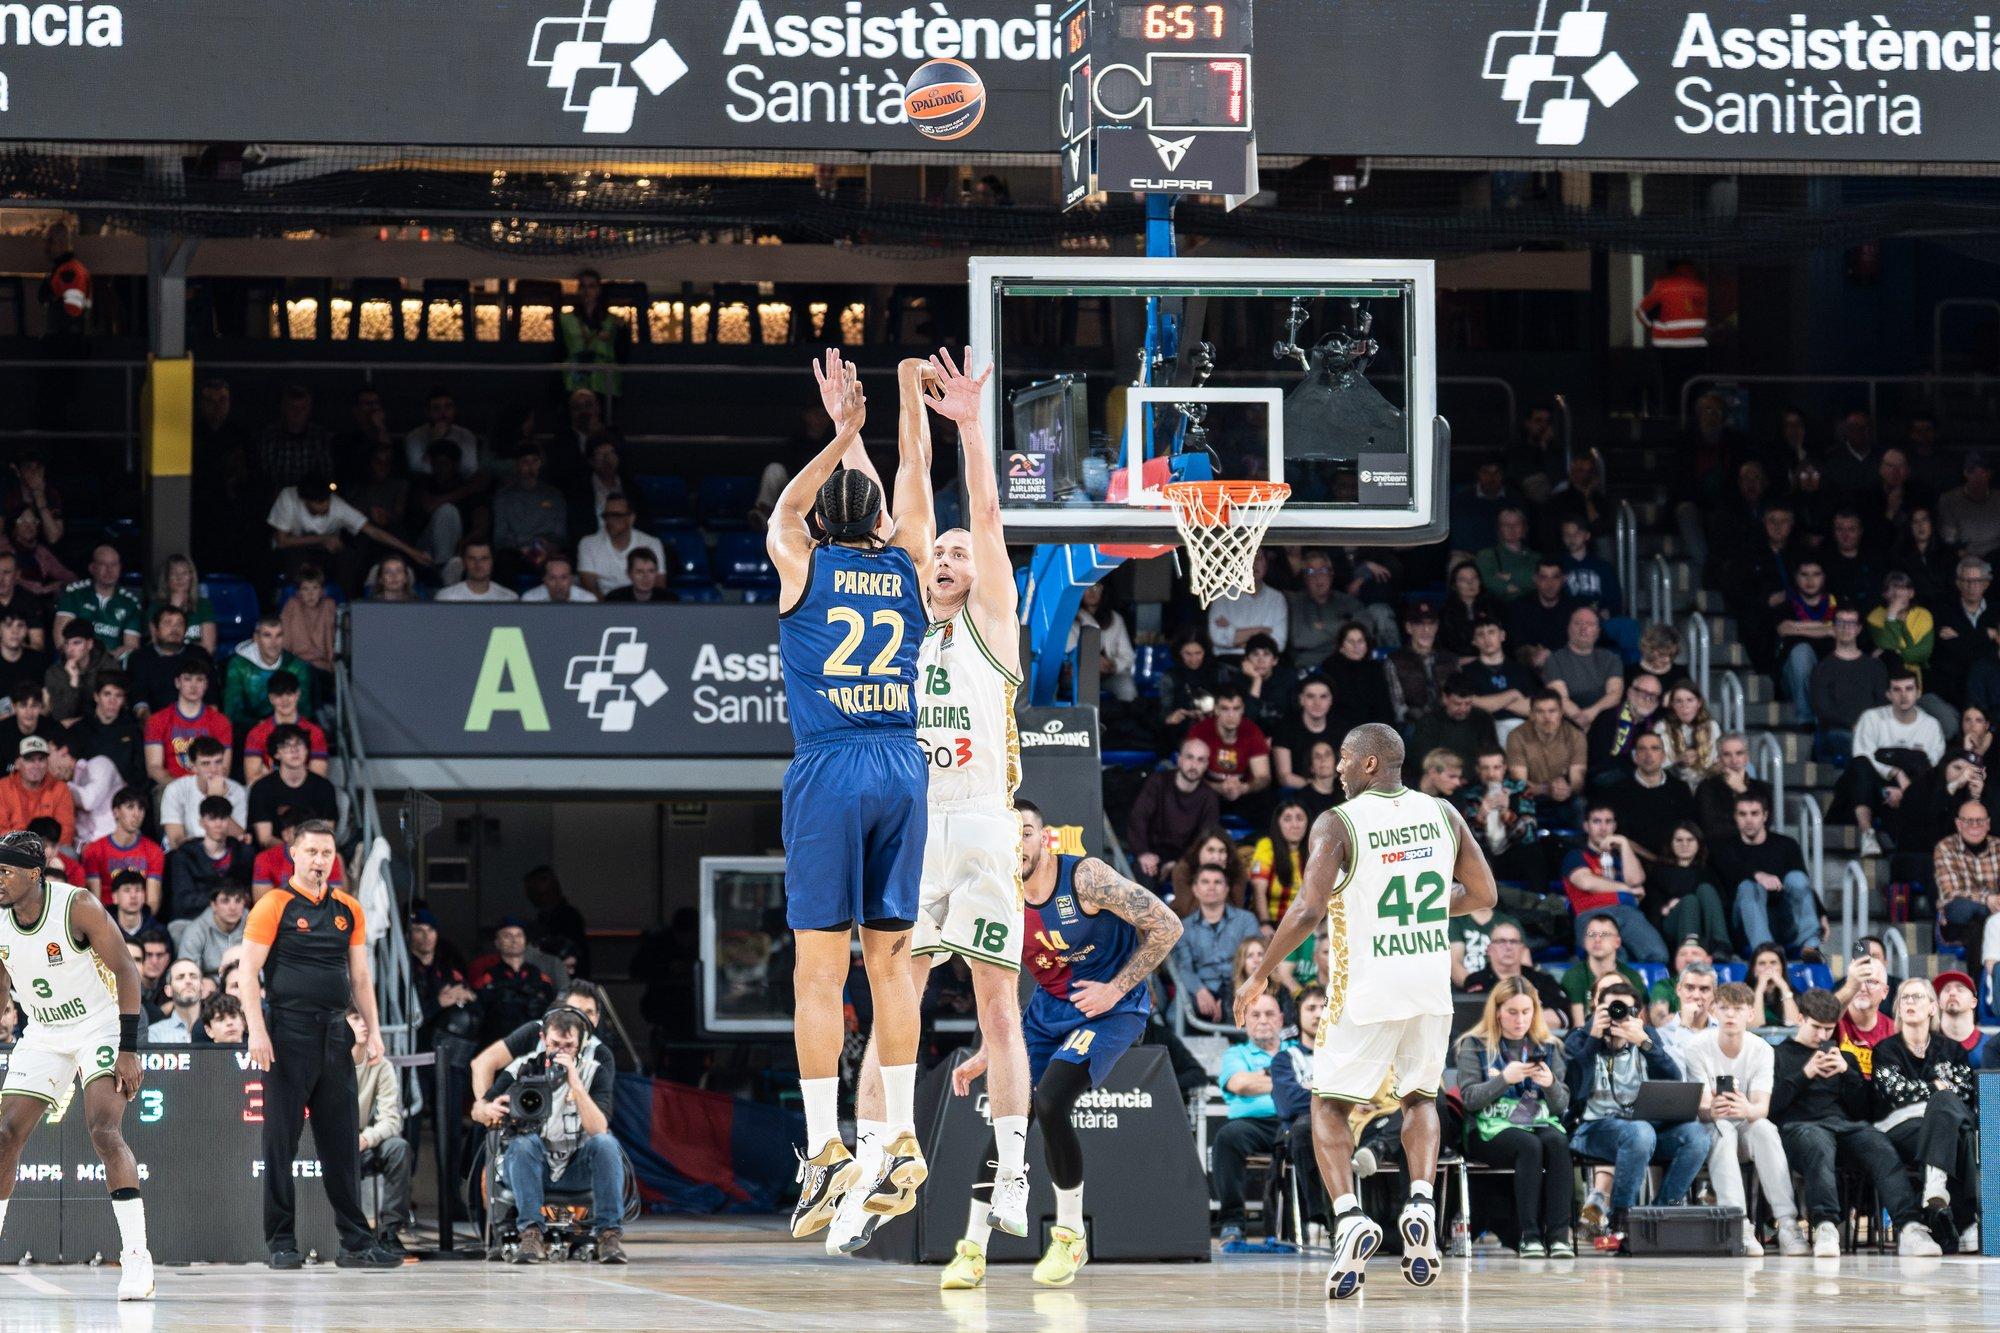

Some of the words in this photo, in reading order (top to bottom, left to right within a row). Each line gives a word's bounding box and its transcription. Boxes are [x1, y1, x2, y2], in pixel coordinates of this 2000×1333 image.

[723, 0, 1061, 60] Assistènci
[1145, 5, 1224, 39] 6:57
[1672, 12, 2000, 71] Assistènci
[912, 90, 964, 113] SPALDING
[1209, 61, 1242, 122] 7
[1674, 76, 1922, 136] Sanitària
[1130, 179, 1213, 190] CUPRA
[1009, 453, 1046, 477] 25
[1010, 477, 1046, 485] TURKISH
[1010, 485, 1046, 493] AIRLINES
[834, 570, 903, 597] PARKER
[823, 606, 905, 676] 22
[690, 643, 784, 682] Assi
[464, 627, 551, 732] A
[925, 664, 951, 696] 18
[1020, 731, 1090, 748] SPALDING
[1368, 822, 1441, 849] DUNSTON
[1377, 871, 1448, 926] 42
[972, 917, 1009, 953] 18
[1373, 928, 1450, 957] KAUNA
[32, 978, 53, 998] 3
[96, 1045, 115, 1068] 3
[1062, 1029, 1096, 1056] 14
[138, 1053, 191, 1070] IODE
[140, 1090, 164, 1122] 3
